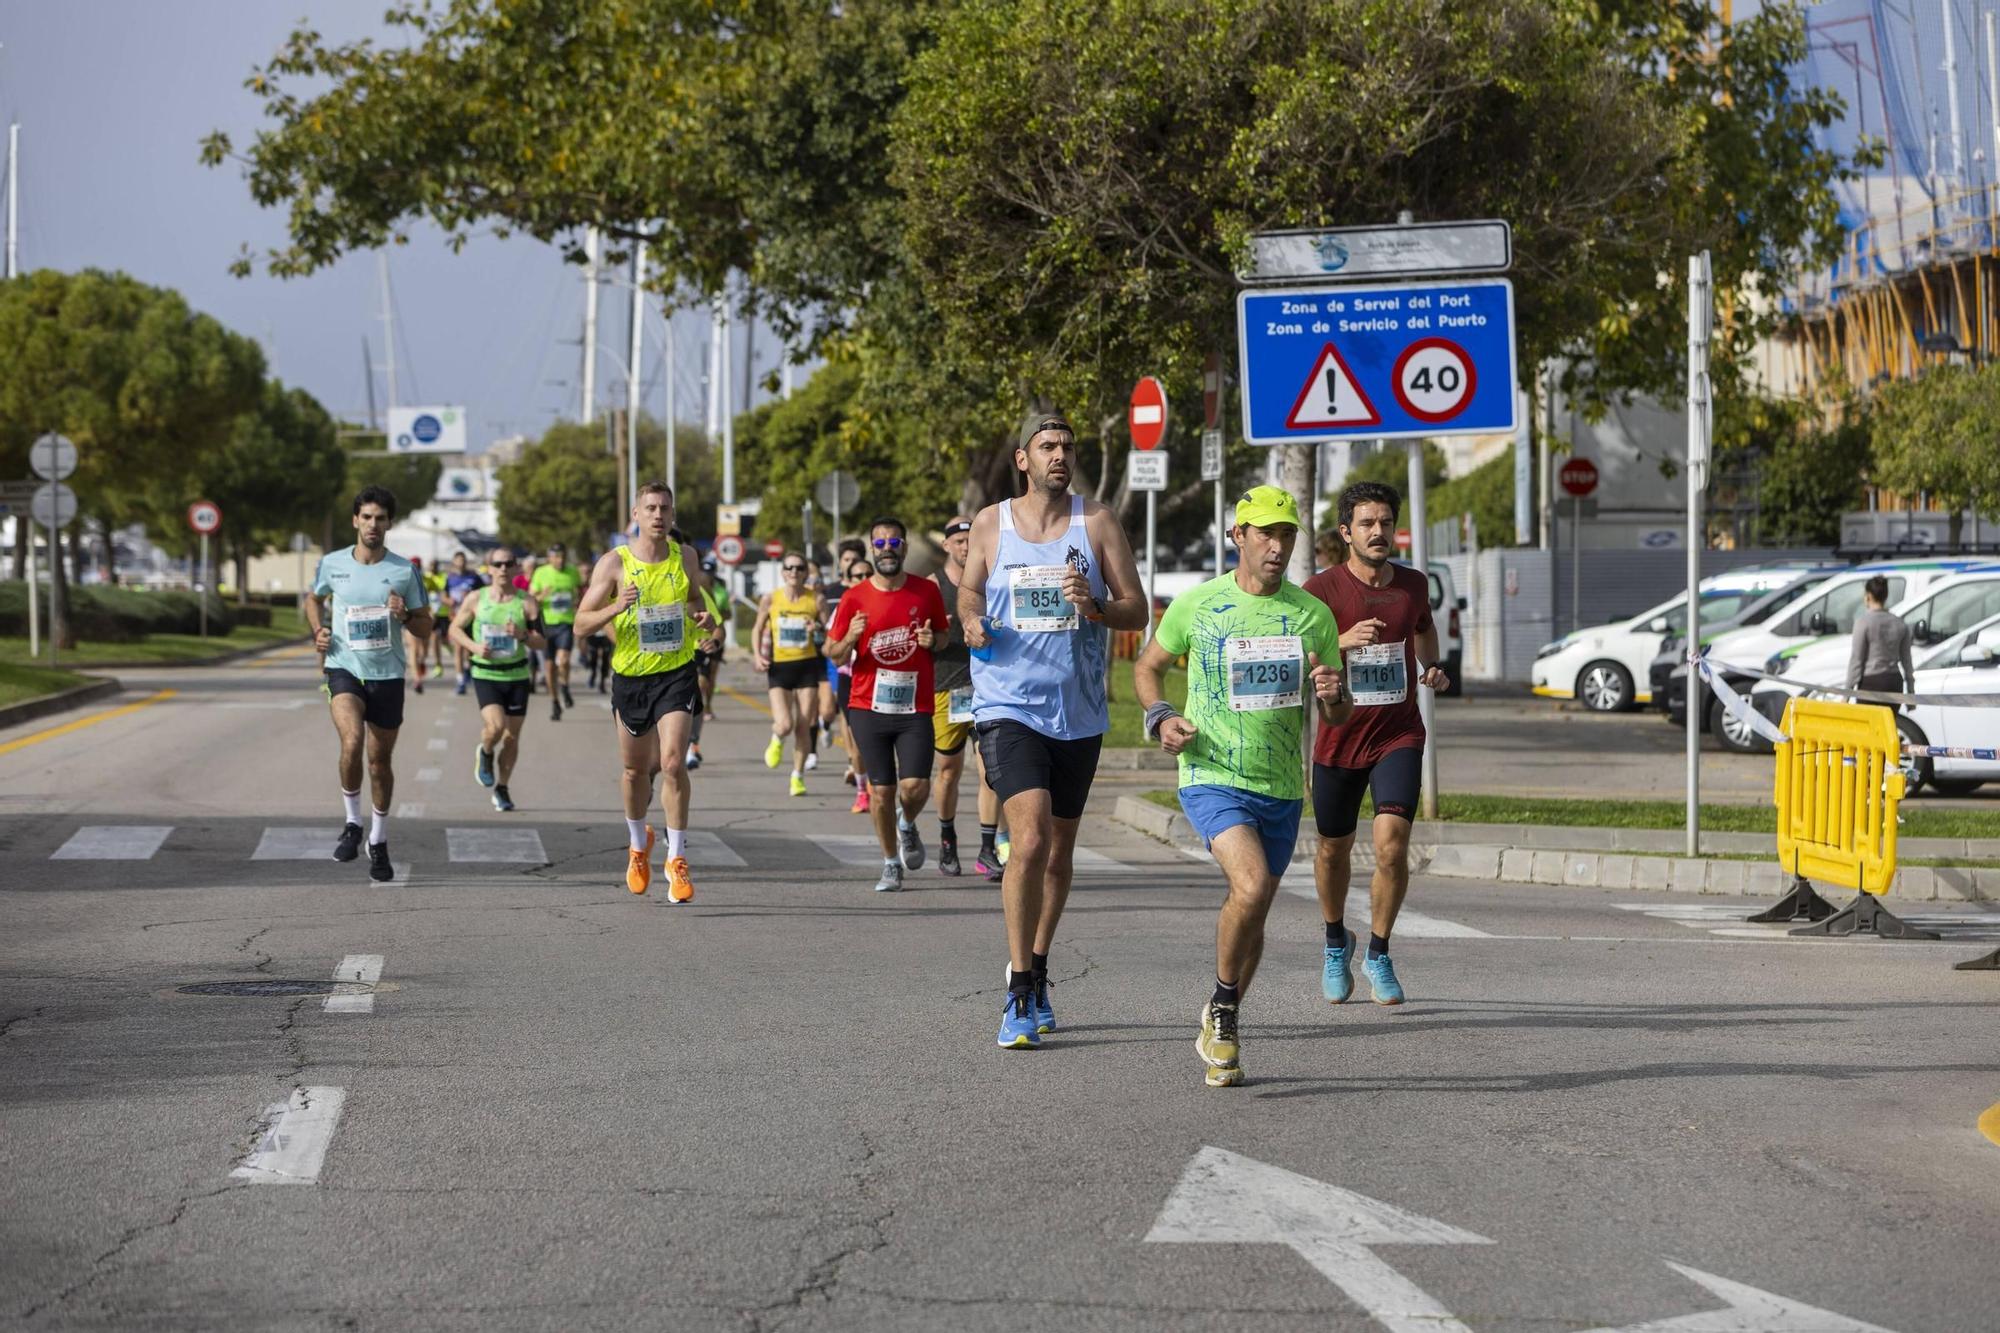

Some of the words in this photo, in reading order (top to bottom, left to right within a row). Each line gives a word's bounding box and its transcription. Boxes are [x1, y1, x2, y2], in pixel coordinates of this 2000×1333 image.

[1282, 302, 1318, 315] Zona
[1327, 300, 1345, 313] de
[1408, 296, 1431, 309] del
[1440, 294, 1471, 308] Port
[1267, 322, 1303, 335] Zona
[1312, 321, 1330, 333] de
[1339, 318, 1398, 332] Servicio
[1407, 316, 1430, 329] del
[1438, 313, 1487, 327] Puerto
[1410, 365, 1460, 393] 40
[1562, 470, 1596, 485] STOP
[1031, 590, 1060, 608] 854
[354, 622, 382, 634] 1068
[653, 622, 674, 636] 528
[1238, 640, 1252, 649] 31
[1356, 647, 1367, 655] 31
[1246, 663, 1289, 684] 1236
[1362, 666, 1395, 683] 1161
[888, 687, 906, 698] 107
